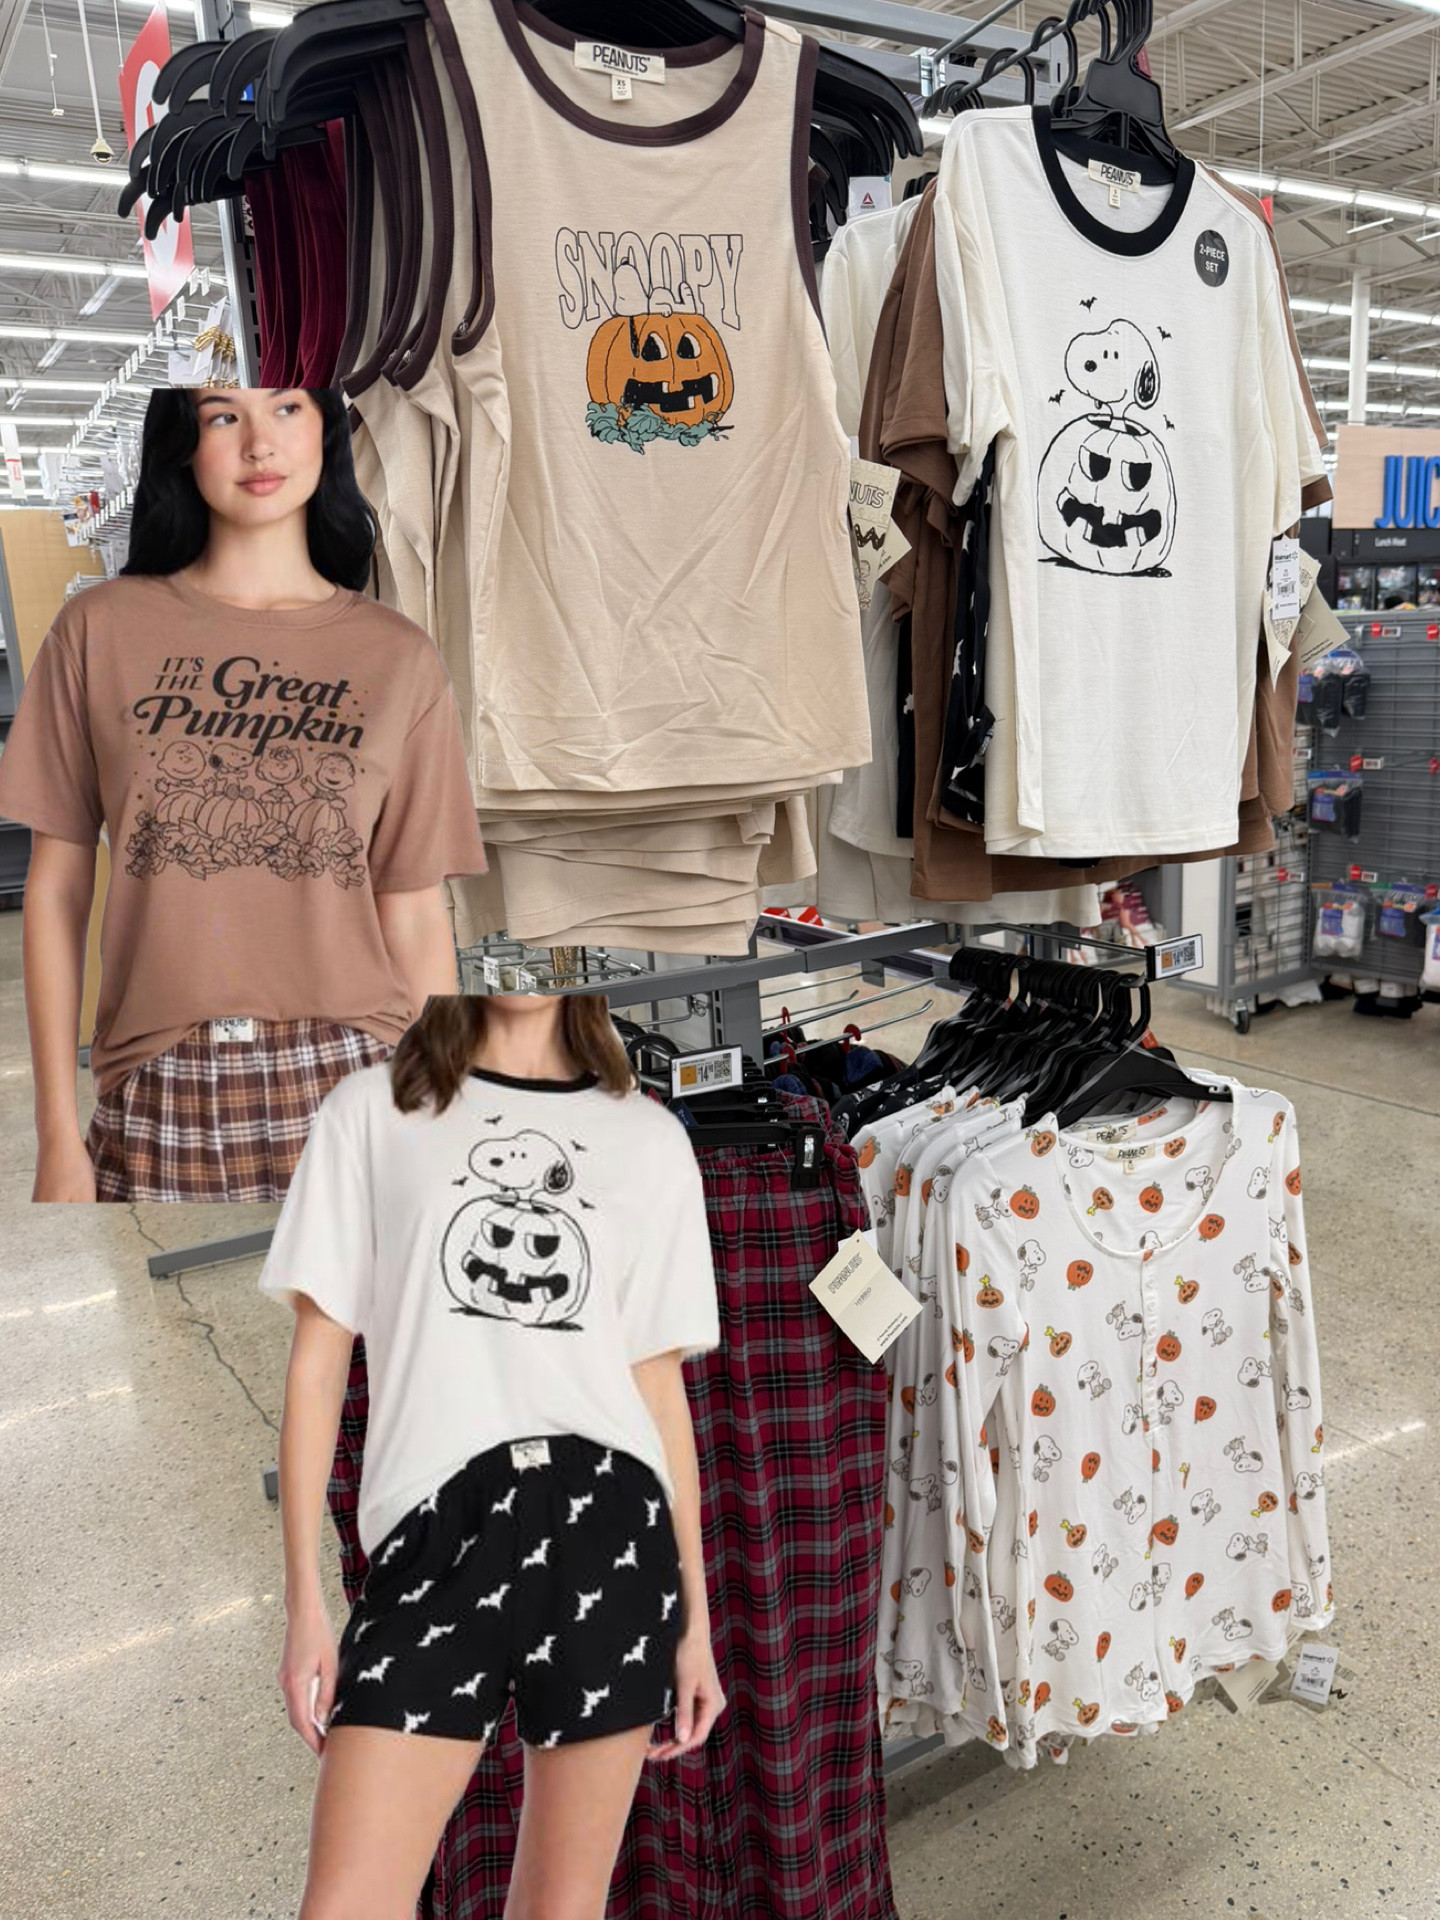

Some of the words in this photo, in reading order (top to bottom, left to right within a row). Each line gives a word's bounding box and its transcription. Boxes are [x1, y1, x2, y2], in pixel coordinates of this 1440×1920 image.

[592, 45, 649, 73] PEANUTS
[1100, 163, 1134, 186] PEANUTS
[1199, 243, 1226, 262] 2-PIECE
[1205, 260, 1219, 274] SET
[555, 226, 744, 331] SNOOPY
[161, 656, 205, 673] IT'S
[154, 674, 204, 691] THE
[212, 655, 352, 709] Great
[133, 694, 364, 757] Pumpkin
[1096, 1125, 1129, 1141] PEANTS
